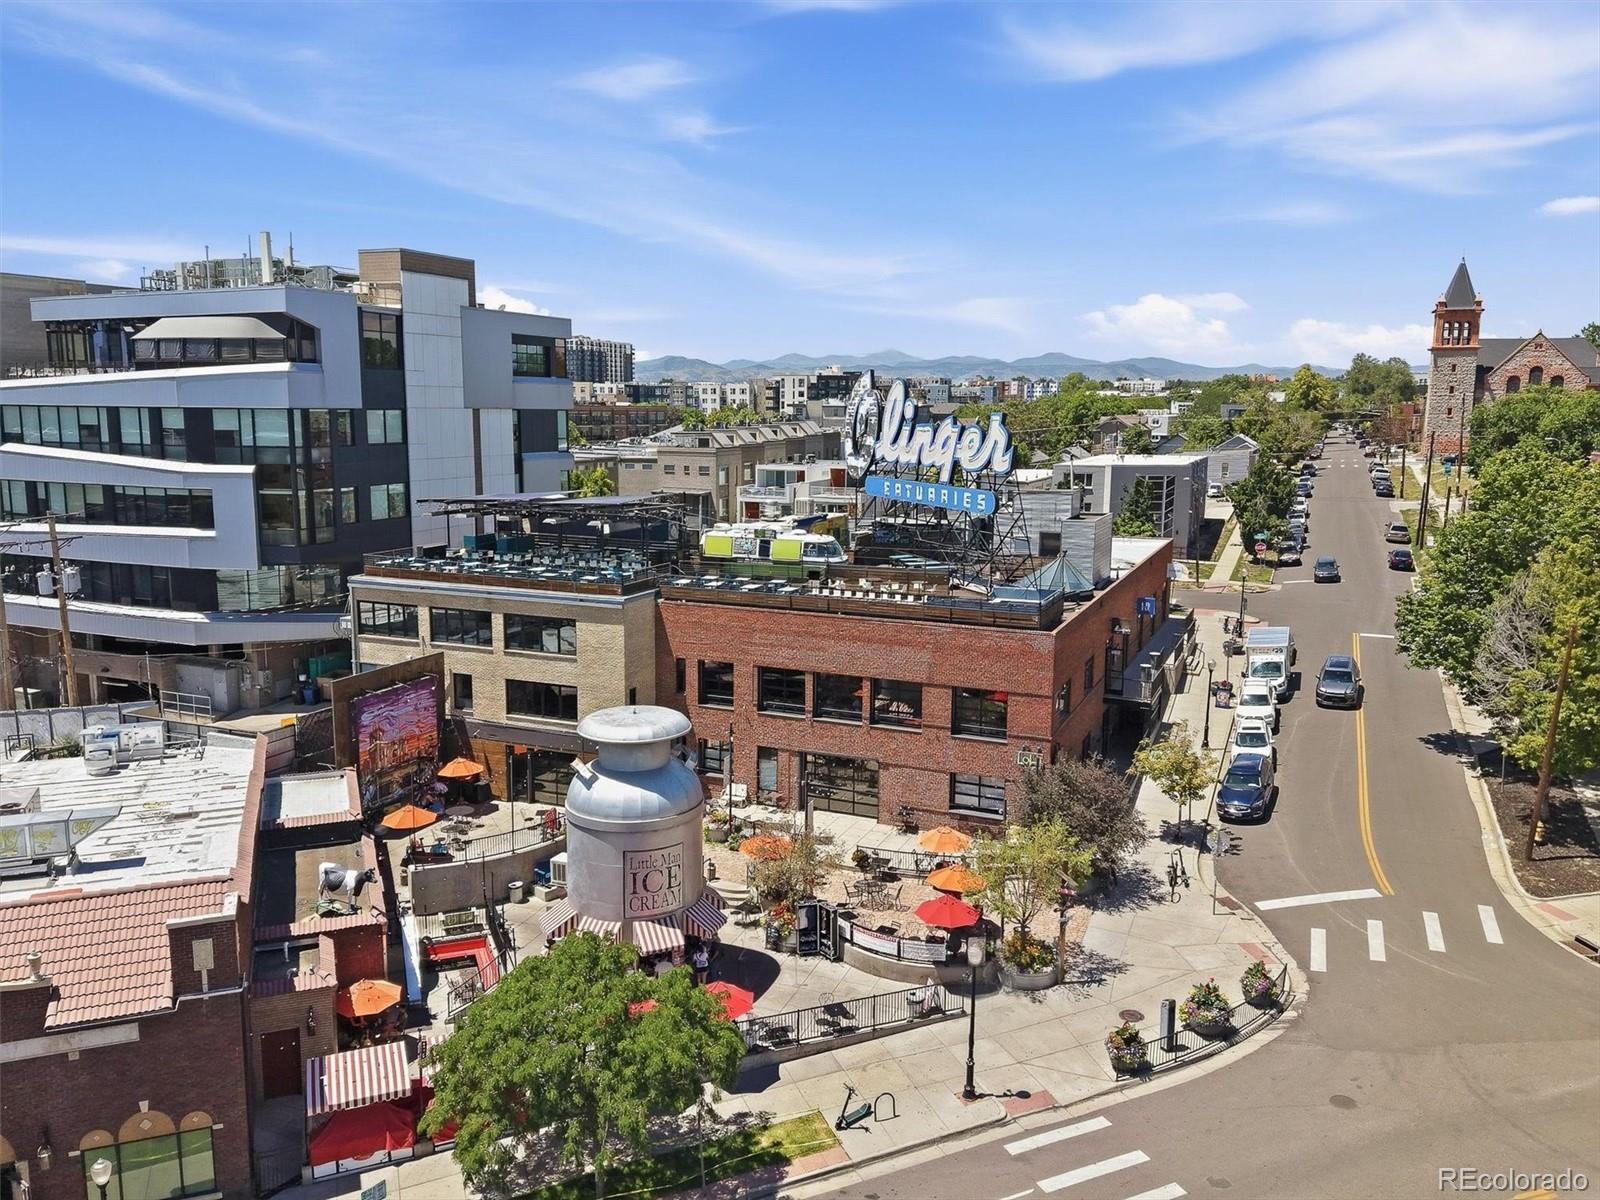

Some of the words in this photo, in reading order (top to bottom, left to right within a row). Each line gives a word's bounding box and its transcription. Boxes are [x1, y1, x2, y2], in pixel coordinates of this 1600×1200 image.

[883, 480, 986, 510] EATUARIES
[629, 854, 658, 870] Little
[660, 851, 681, 867] Man
[629, 864, 681, 895] ICE
[629, 889, 681, 912] CREAM
